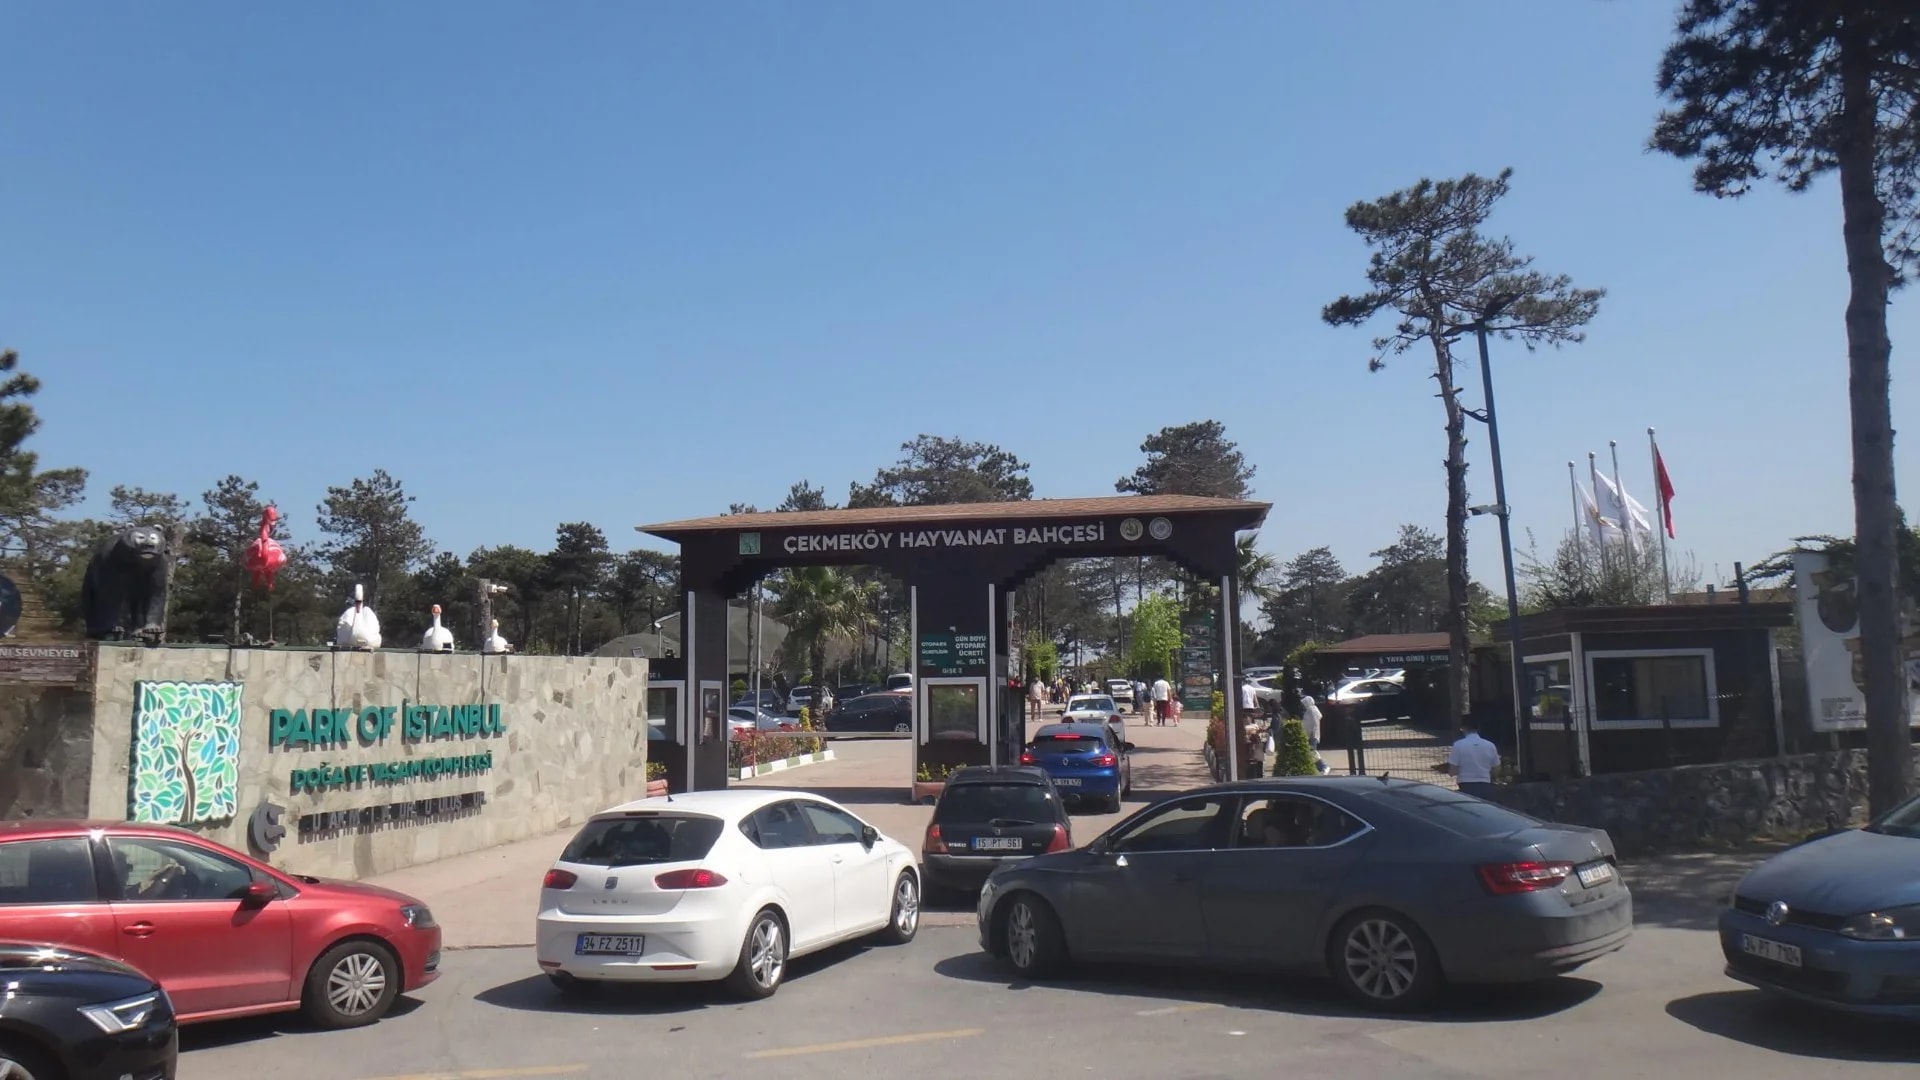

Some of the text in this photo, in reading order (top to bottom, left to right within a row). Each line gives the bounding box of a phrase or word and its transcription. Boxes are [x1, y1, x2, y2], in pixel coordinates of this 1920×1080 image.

[784, 521, 1105, 554] ÇEKMEKÖY HAYVANAT BAHÇESİ
[15, 647, 79, 658] SEVMEYEN
[269, 697, 507, 747] PARK OF İSTANBUL
[290, 750, 493, 790] DOĞA VE YAŞAM KOMPLEKSİ
[992, 839, 1001, 848] PT
[1007, 839, 1021, 848] 961
[584, 937, 641, 951] 34 FZ 2511
